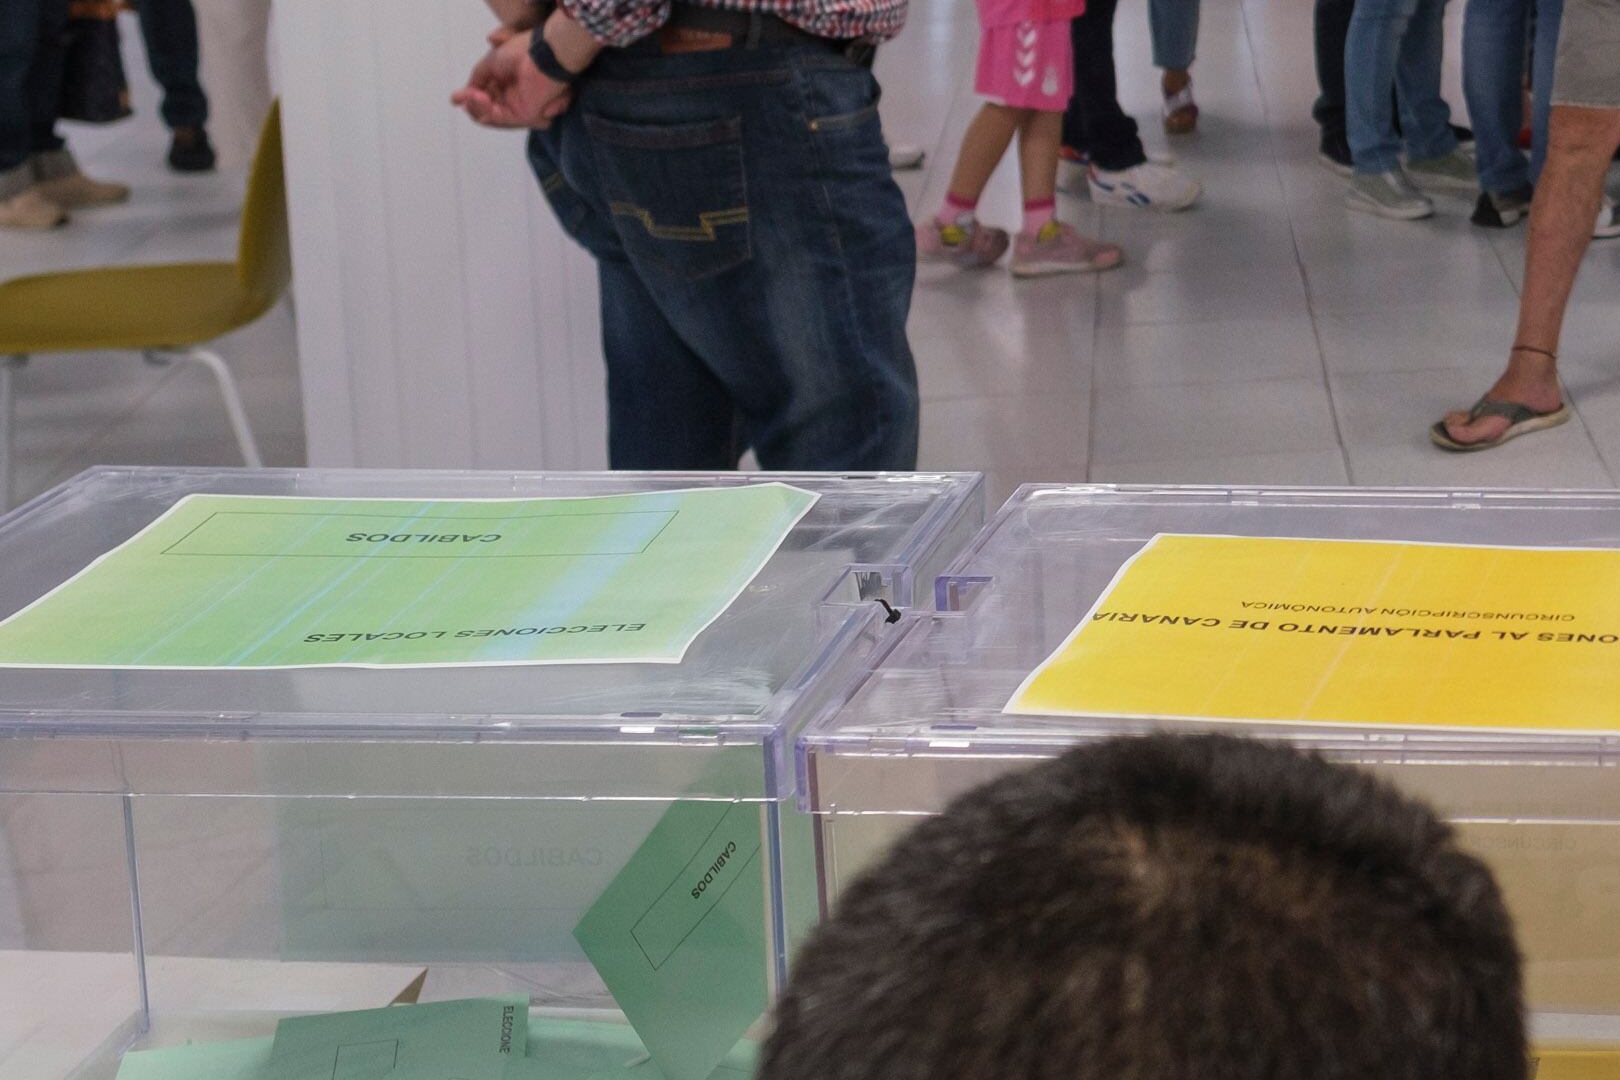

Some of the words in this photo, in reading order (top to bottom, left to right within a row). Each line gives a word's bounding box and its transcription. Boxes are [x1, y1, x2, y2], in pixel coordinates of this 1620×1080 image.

[346, 532, 503, 543] CABILDOS
[1092, 612, 1220, 627] CANARIA
[1230, 620, 1270, 631] DE
[304, 629, 446, 643] LOCALES
[455, 622, 647, 638] ELECCIONES
[1279, 622, 1481, 640] PARLAMENTO
[1491, 630, 1529, 640] AL
[691, 840, 737, 900] CABILDOS
